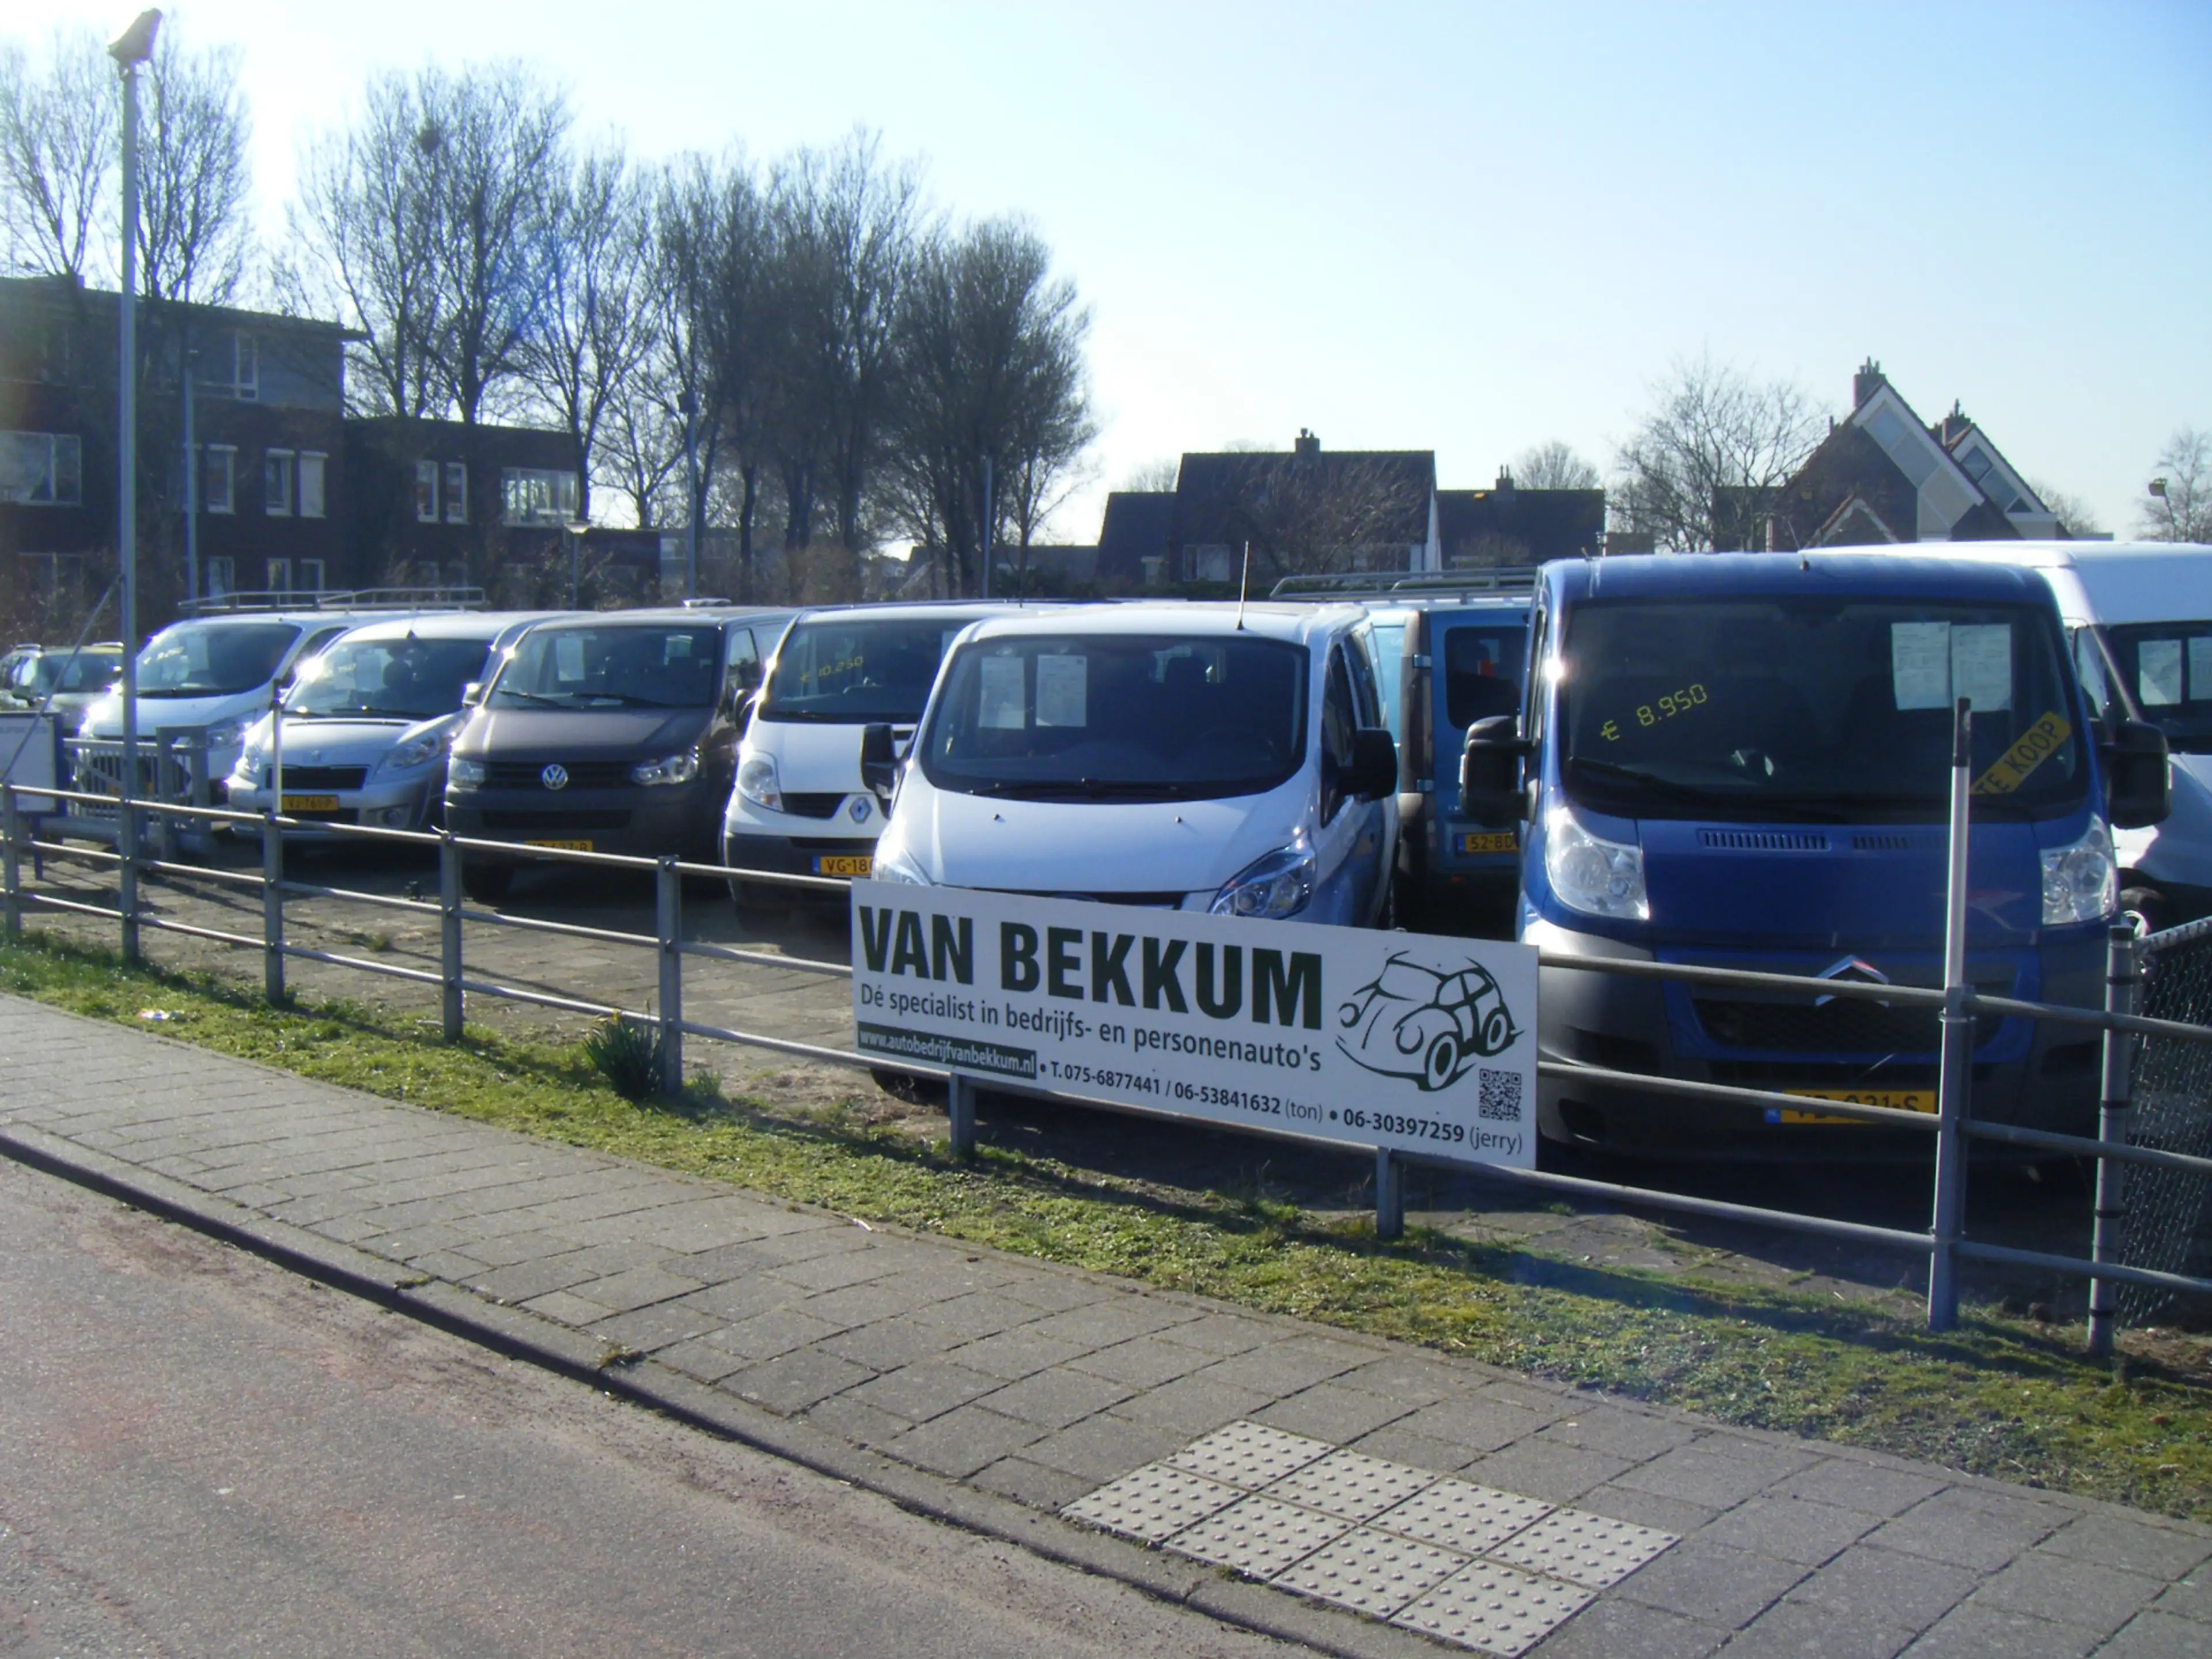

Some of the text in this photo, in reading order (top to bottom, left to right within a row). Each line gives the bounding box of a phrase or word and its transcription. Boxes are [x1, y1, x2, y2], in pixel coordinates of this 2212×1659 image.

[1600, 684, 1707, 741] € 8.950
[2003, 721, 2058, 775] KOOP
[859, 906, 1322, 1031] VAN BEKKUM
[861, 983, 1321, 1071] Dé specialist in bedrijfs- en personenauto's
[859, 1030, 1036, 1074] www.autobedrijfvanbekkum.nl
[1174, 1082, 1281, 1115] 06-53841632
[1285, 1099, 1324, 1123] (ton)
[1343, 1108, 1464, 1143] 06-30397259
[1469, 1126, 1523, 1155] (jerry)
